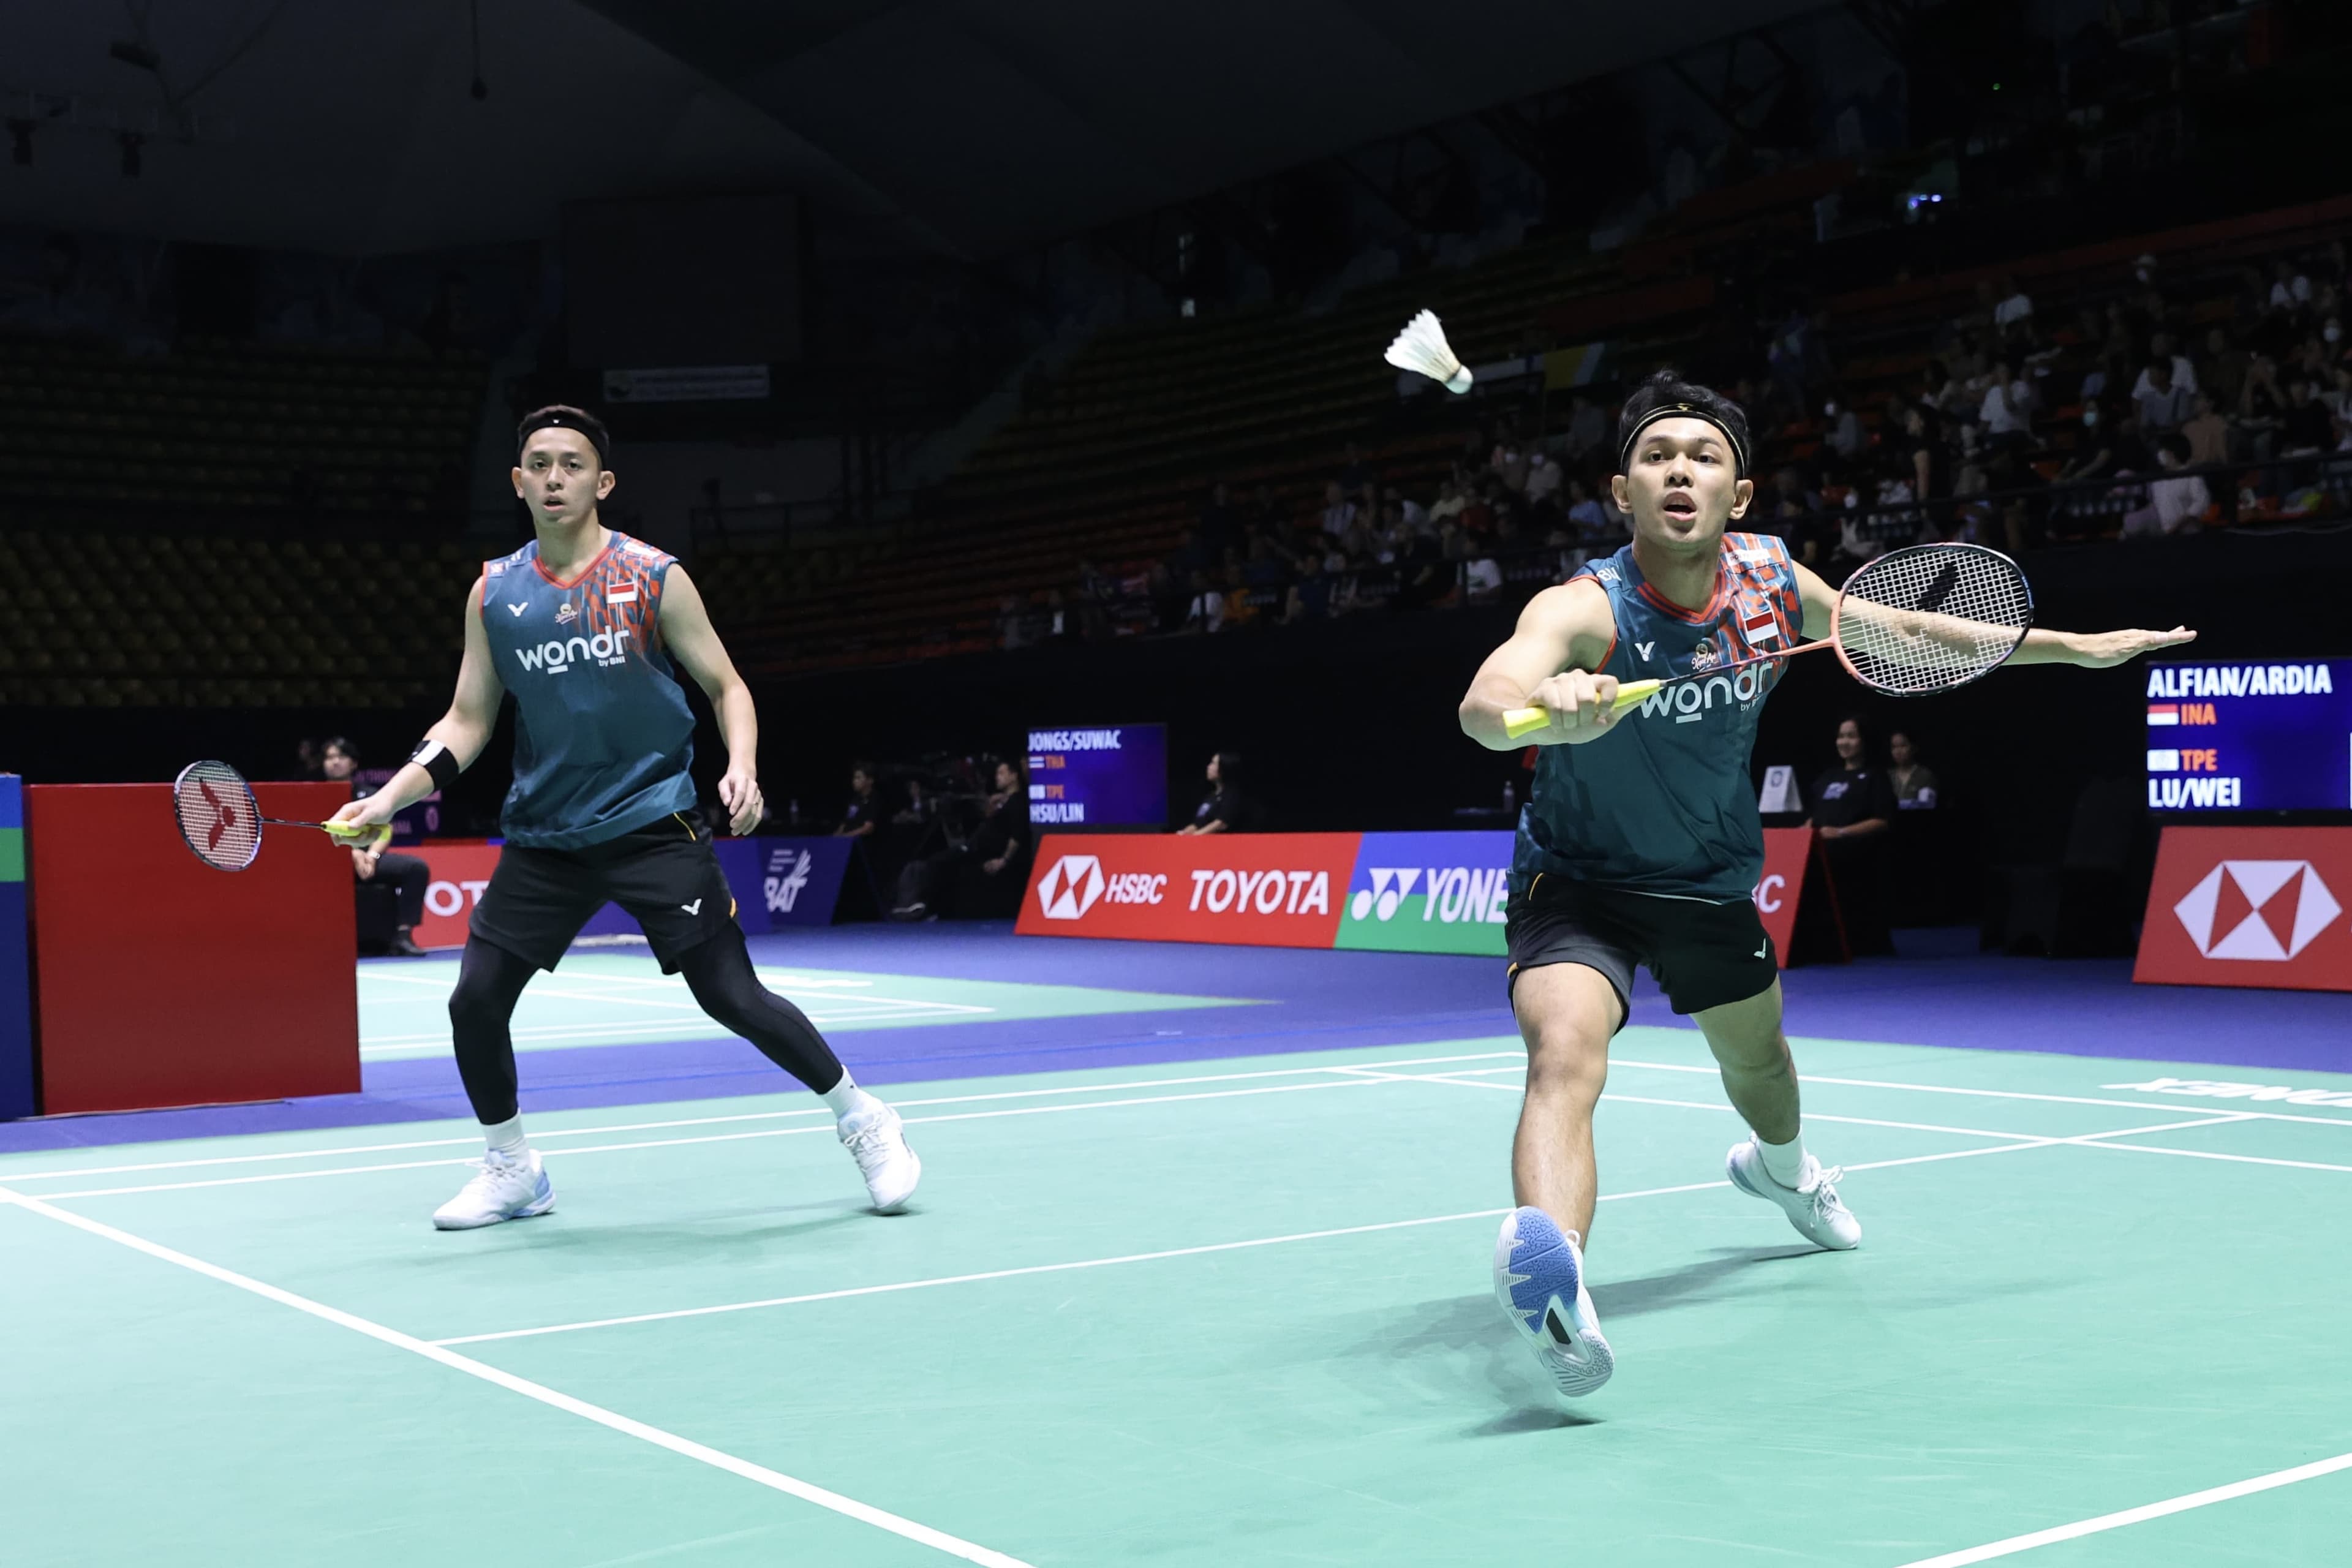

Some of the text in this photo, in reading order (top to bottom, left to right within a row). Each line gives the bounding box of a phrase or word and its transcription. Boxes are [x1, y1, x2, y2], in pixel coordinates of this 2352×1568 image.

[516, 625, 629, 674] wondr
[609, 656, 625, 665] BNI
[1642, 661, 1774, 723] wondr
[2147, 664, 2332, 698] ALFIAN/ARDIA
[2181, 704, 2217, 725] INA
[1028, 729, 1121, 752] JONGS/SUWAC
[2181, 749, 2217, 771] TPE
[2149, 778, 2241, 809] LU/WEI
[1030, 803, 1084, 823] HSU/LIN
[424, 880, 490, 917] OT
[1105, 873, 1168, 905] HSBC
[1189, 870, 1329, 915] TOYOTA
[1422, 867, 1509, 924] YONE
